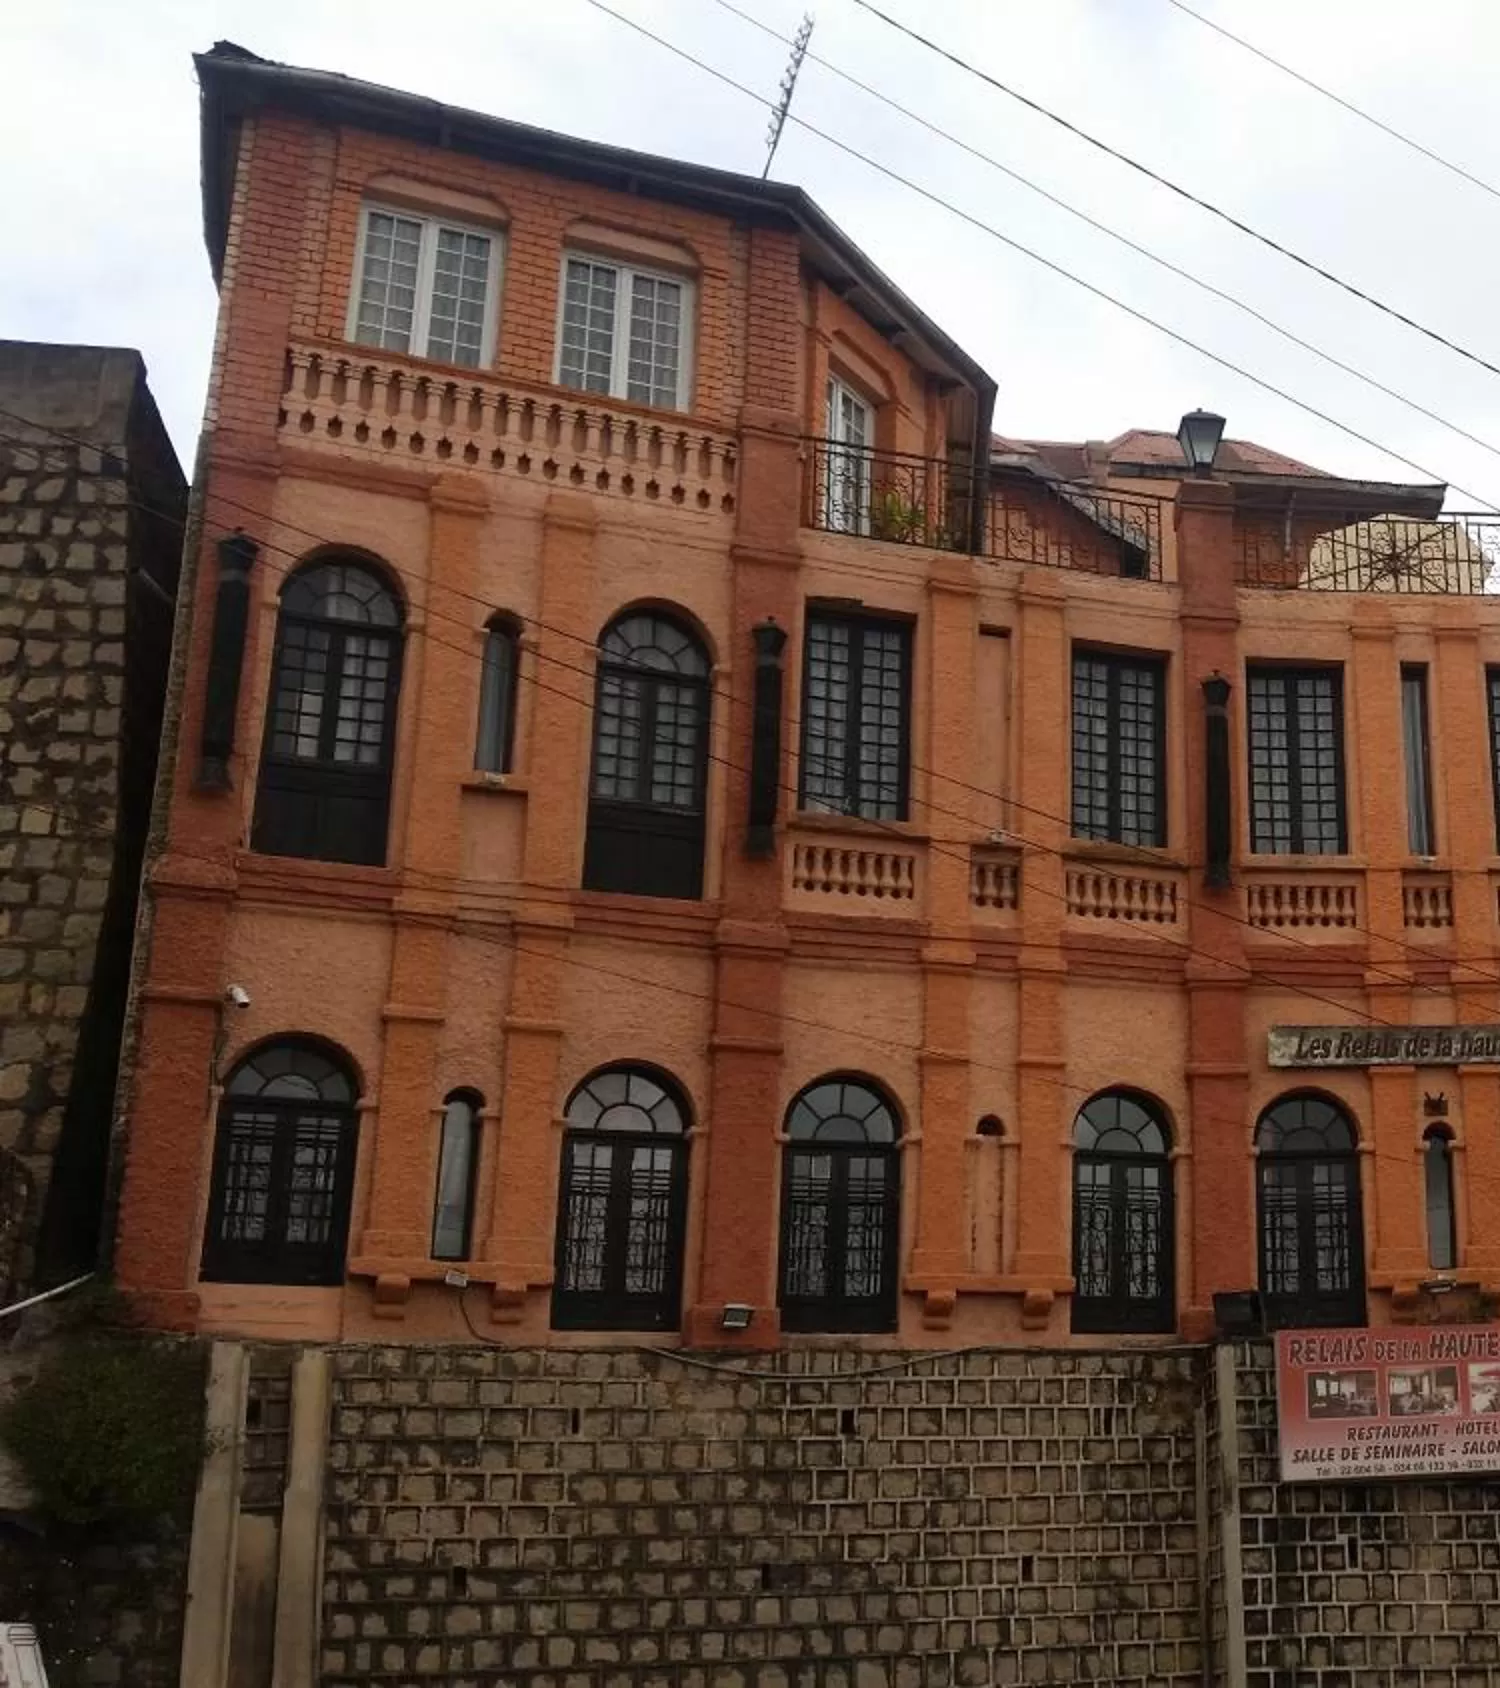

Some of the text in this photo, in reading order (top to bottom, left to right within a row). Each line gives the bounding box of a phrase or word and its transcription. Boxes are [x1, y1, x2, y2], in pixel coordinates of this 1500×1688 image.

[1296, 1032, 1333, 1059] Les
[1335, 1032, 1402, 1059] Relais
[1404, 1031, 1430, 1058] de
[1434, 1031, 1452, 1057] la
[1288, 1334, 1368, 1365] RELAIS
[1375, 1341, 1397, 1362] DE
[1403, 1340, 1421, 1361] LA
[1429, 1331, 1499, 1360] HAUTE
[1347, 1422, 1440, 1442] RESTAURANT
[1292, 1447, 1335, 1463] SALLE
[1341, 1447, 1359, 1461] DE
